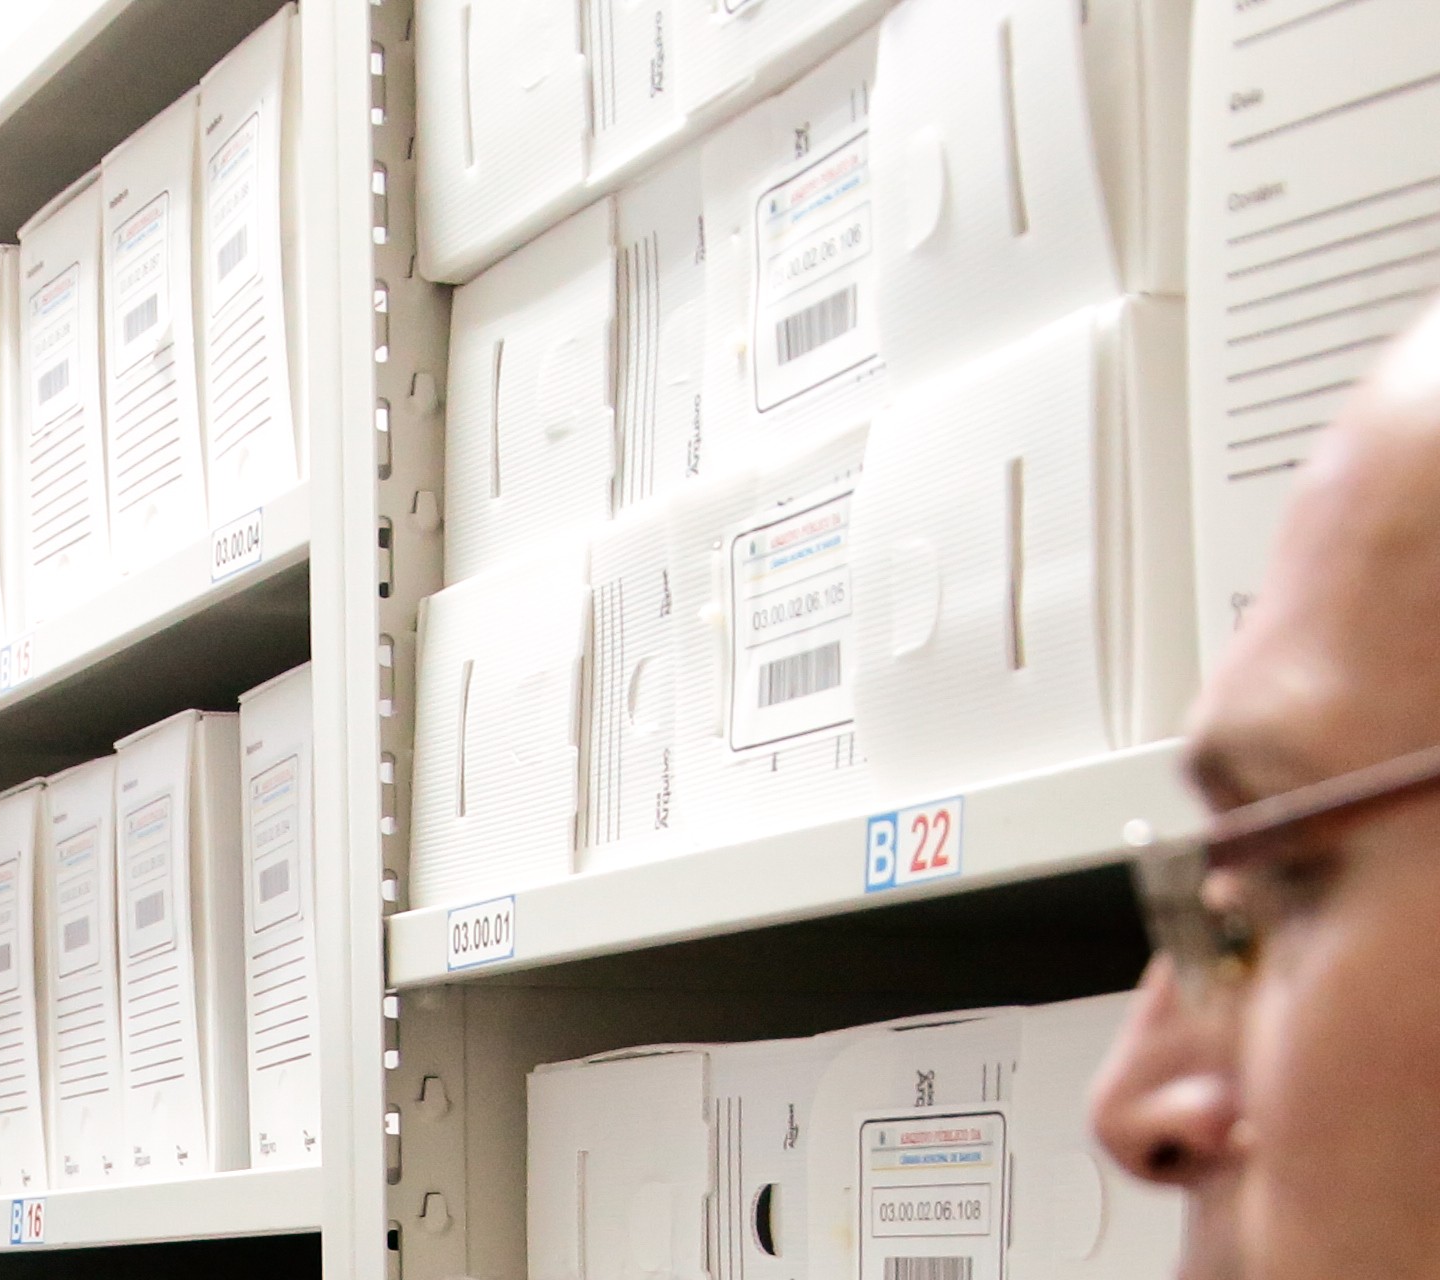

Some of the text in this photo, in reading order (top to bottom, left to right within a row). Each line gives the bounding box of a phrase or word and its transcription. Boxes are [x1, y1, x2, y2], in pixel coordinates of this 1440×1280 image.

[215, 521, 260, 567] 03.00.04
[16, 641, 31, 678] 15
[868, 809, 951, 888] B 22
[452, 911, 511, 955] 03.00.01
[12, 1203, 42, 1239] B 16
[879, 1200, 982, 1222] 03.00.02.06.108
